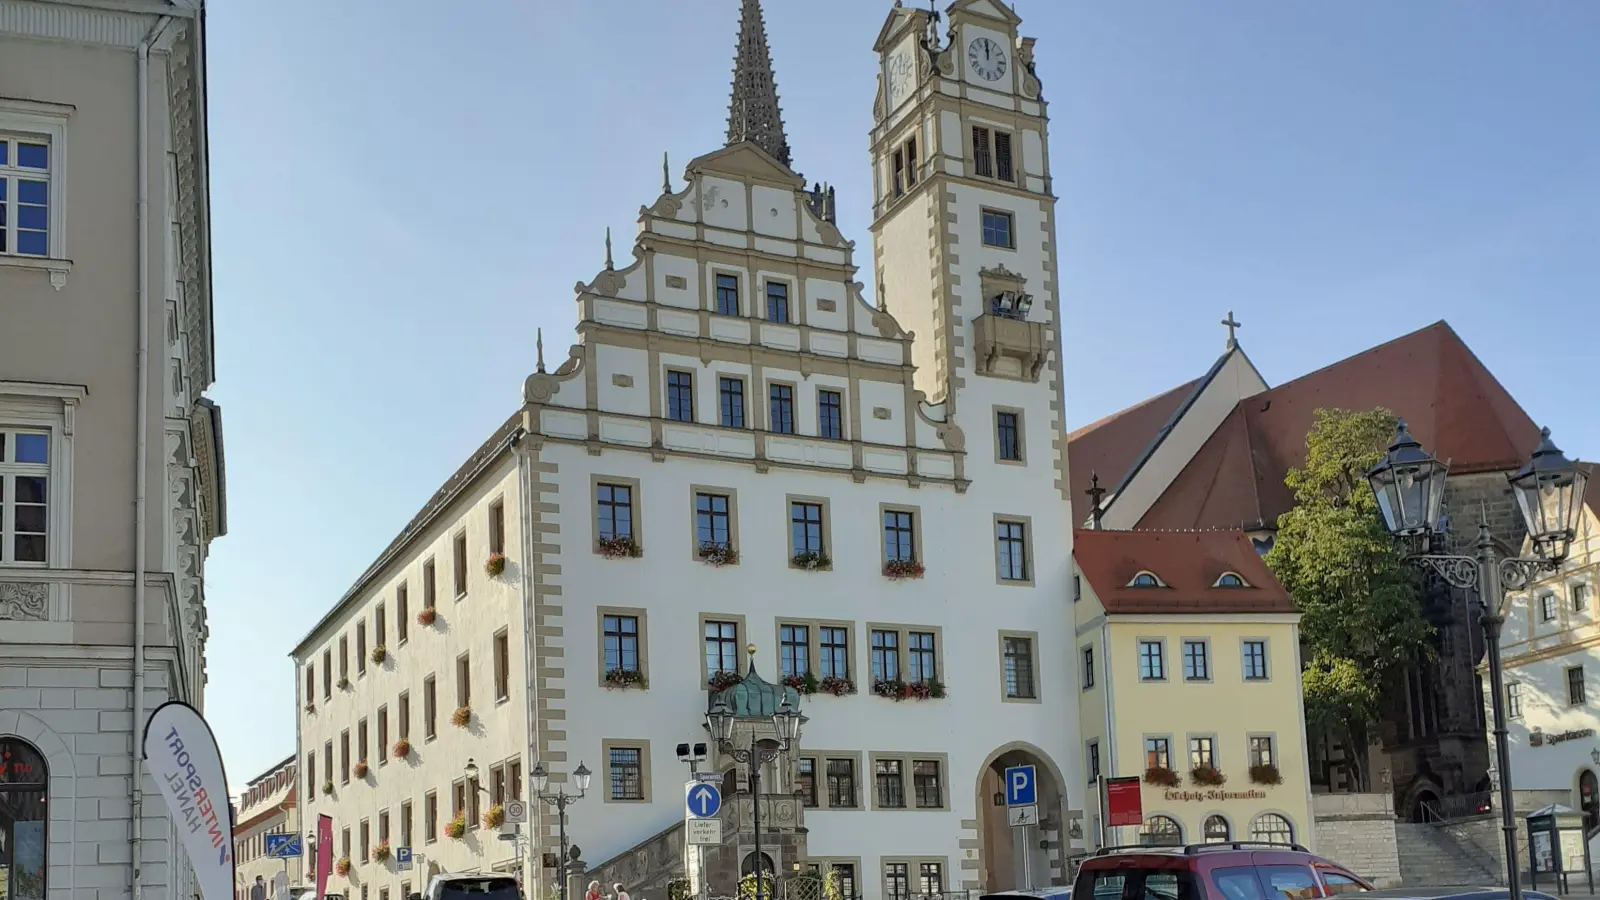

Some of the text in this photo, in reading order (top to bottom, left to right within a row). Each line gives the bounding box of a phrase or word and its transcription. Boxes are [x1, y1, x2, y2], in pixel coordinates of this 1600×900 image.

[1546, 728, 1592, 745] Sparkasse
[1013, 772, 1028, 800] P
[511, 806, 521, 814] 30
[400, 849, 409, 860] P
